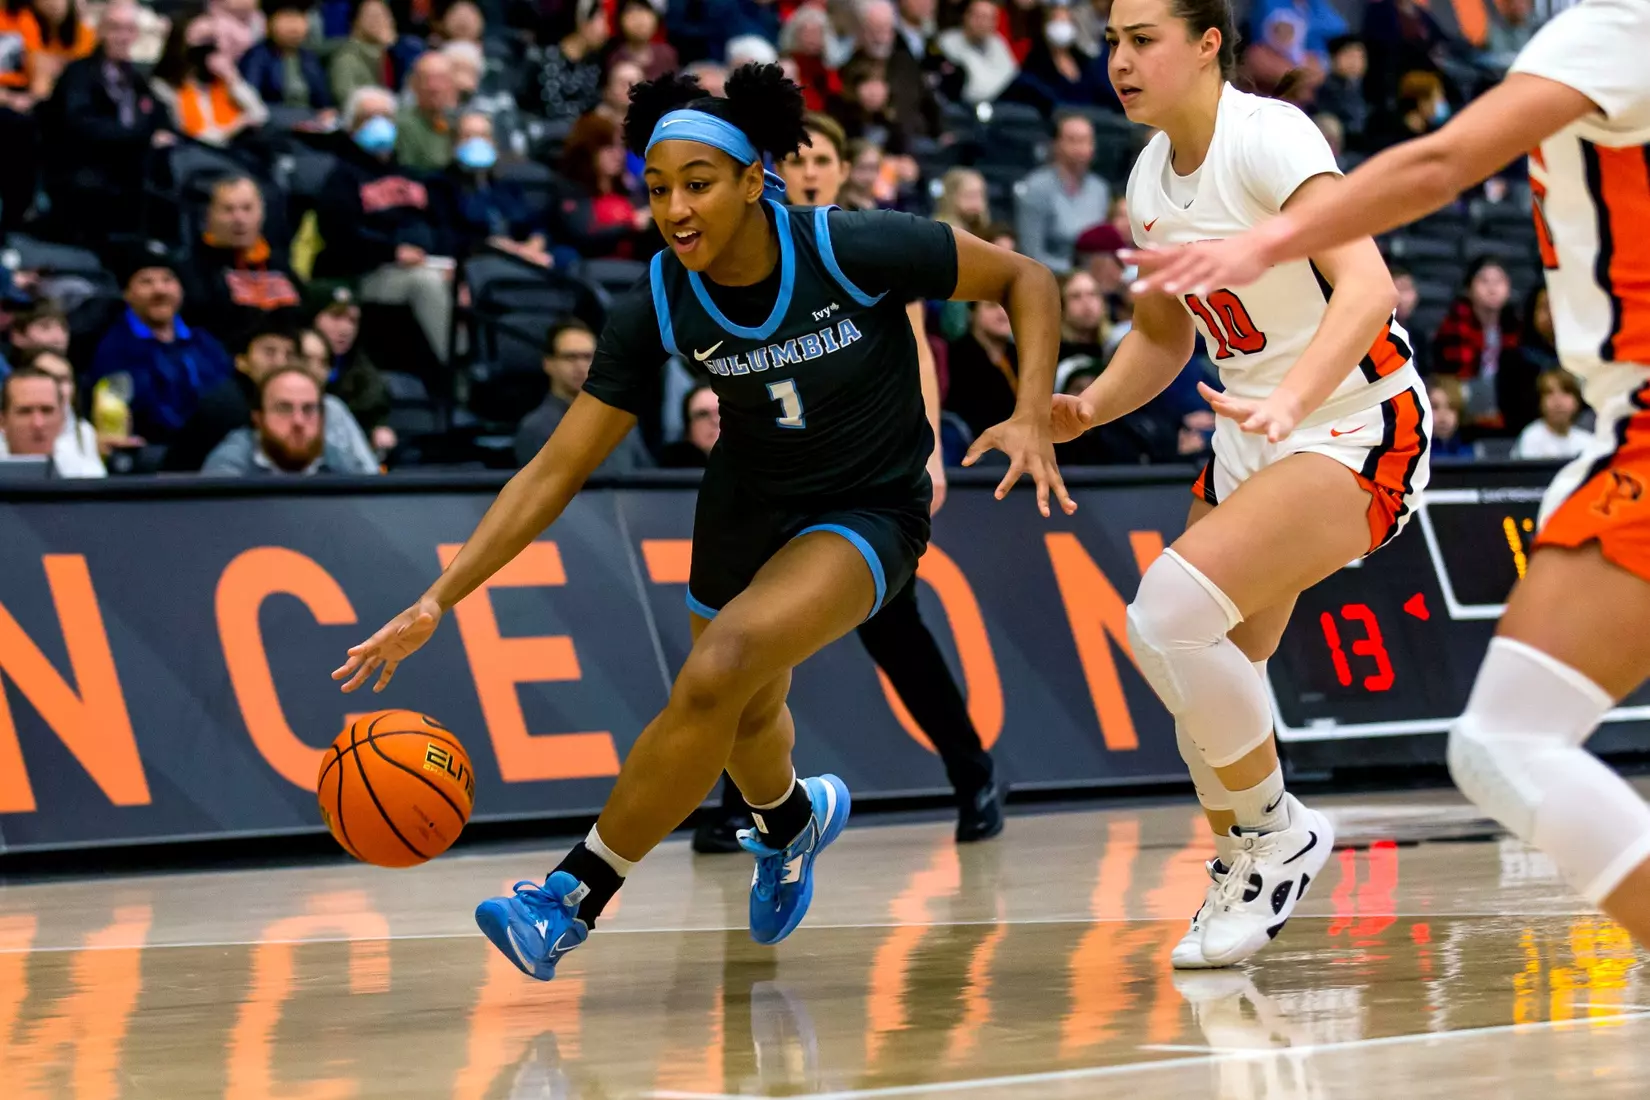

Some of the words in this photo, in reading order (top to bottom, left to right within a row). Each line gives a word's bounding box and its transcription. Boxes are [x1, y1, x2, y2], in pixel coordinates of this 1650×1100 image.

[811, 305, 832, 322] Ivy
[1184, 288, 1267, 360] 10
[703, 318, 863, 377] COLUMBIA
[765, 377, 806, 429] 1
[0, 531, 1175, 812] NCEON
[1319, 603, 1395, 692] 13
